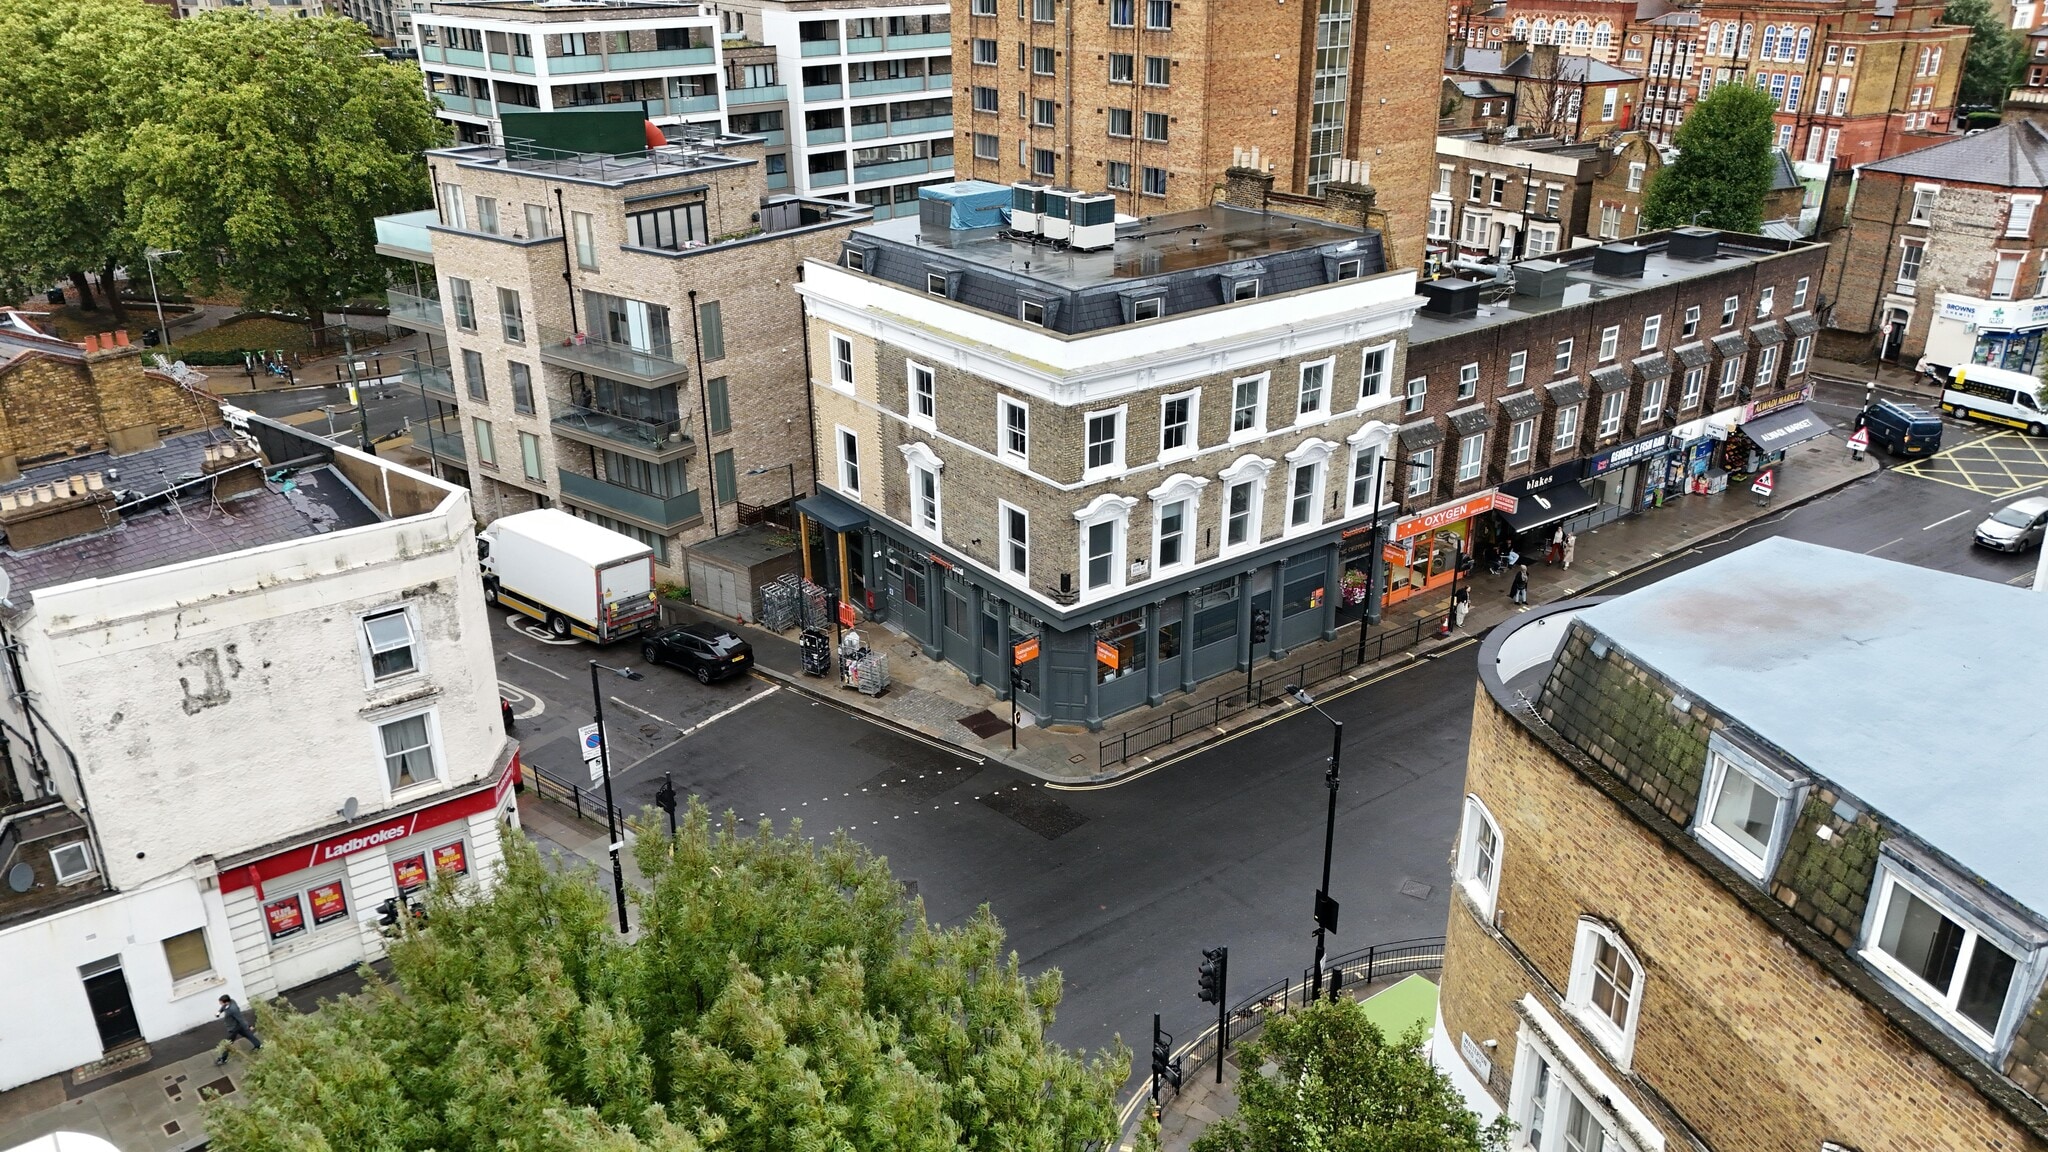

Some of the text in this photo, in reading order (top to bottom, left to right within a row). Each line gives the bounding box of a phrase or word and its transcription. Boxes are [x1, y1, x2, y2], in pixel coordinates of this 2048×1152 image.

[1945, 310, 1975, 318] CHEMIST
[1946, 303, 1976, 314] BROWNS
[1754, 397, 1778, 413] ALWADI
[1777, 390, 1801, 407] MARKET
[1761, 418, 1813, 442] ALWADI MARKET
[1640, 439, 1654, 453] FISH
[1653, 435, 1666, 449] BAR
[1526, 475, 1553, 490] blakes
[1496, 494, 1514, 505] OXYGEN
[1424, 504, 1468, 527] OXYGEN
[324, 825, 405, 859] Ladbrokes
[1463, 1042, 1475, 1059] ROAD
[1464, 1037, 1488, 1067] WALTERTON
